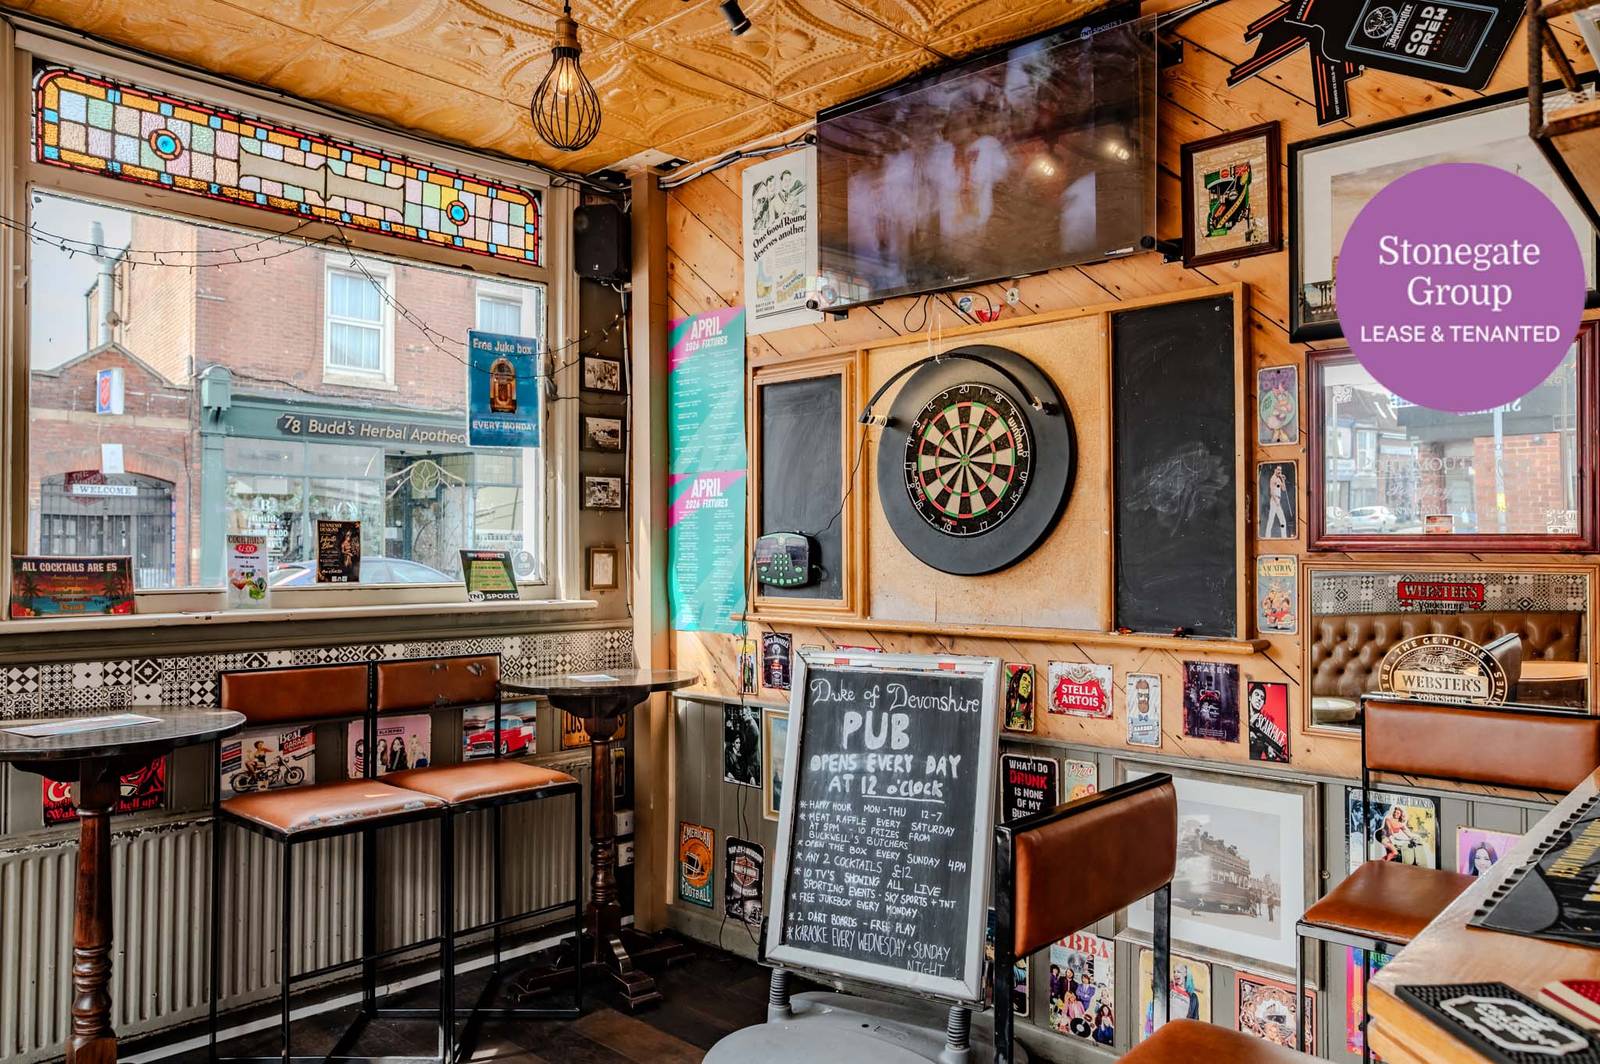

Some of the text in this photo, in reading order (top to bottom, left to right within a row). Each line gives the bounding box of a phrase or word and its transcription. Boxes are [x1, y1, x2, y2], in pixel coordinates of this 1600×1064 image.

[1405, 6, 1435, 54] COLD
[1416, 8, 1448, 56] BREW
[753, 235, 766, 248] One
[784, 212, 807, 228] Round
[690, 316, 722, 340] APRIL
[495, 341, 515, 354] Juke
[517, 344, 532, 354] box
[958, 385, 970, 394] 20
[284, 415, 300, 434] 78
[308, 419, 356, 435] Budd's
[360, 423, 407, 439] Herbal
[473, 420, 536, 430] EVERY MONDAY
[80, 486, 132, 495] WELCOME
[690, 478, 724, 498] APRIL
[22, 562, 118, 572] ALL COCKTAILS ARE £5
[1404, 584, 1478, 598] WEBSTER'S
[1396, 636, 1486, 660] THE GENUINE
[1190, 664, 1231, 674] KRAKEN
[1061, 684, 1098, 696] STELLA
[1402, 674, 1481, 692] WEBSTER'S
[810, 678, 980, 712] Duke of Devonshire
[1061, 695, 1100, 708] ARTOIS
[1416, 692, 1467, 705] YORKSHIRE
[280, 728, 301, 744] Best
[842, 710, 912, 750] PUB
[1256, 714, 1287, 747] SCARFACE
[810, 753, 962, 779] OPENS EVERY DAY
[1008, 760, 1031, 771] WHAT
[1038, 763, 1048, 774] DO
[828, 774, 855, 793] AT
[862, 775, 878, 795] 12
[1008, 770, 1048, 790] DRUNK
[1014, 787, 1044, 800] IS NONE
[46, 808, 76, 820] Wak
[810, 800, 830, 810] HAPPY
[832, 802, 852, 812] HOUR
[1016, 798, 1041, 811] OF MY
[810, 812, 956, 836] MEAT RAFFLE EVERY SATURDAY
[810, 822, 819, 830] AT
[823, 822, 840, 832] 5PM
[870, 826, 900, 839] PRIZES
[909, 832, 930, 842] FROM
[809, 831, 908, 850] BUCKWELL'S BUTCHERS
[804, 840, 967, 872] OPEN THE BOX EVERY SUNDAY 4PM
[805, 852, 913, 878] ANY 2 COCKTAILS £12
[682, 876, 711, 902] FOOTBALL
[803, 868, 942, 896] 10 TV'S SHOWING ALL LIVE
[803, 880, 844, 894] SPORTING
[848, 887, 876, 899] EVENTS
[884, 891, 899, 902] SKY
[900, 894, 928, 908] SPORTS
[939, 899, 957, 908] TNT
[799, 892, 918, 919] FREE JUKEBOX EVERY MONDAY
[798, 912, 916, 937] 2 DART BOARDS FREE PLAY
[794, 924, 951, 960] KARAOKE EVERY WEDNESDAY SUNDAY
[907, 960, 945, 977] NIGHT
